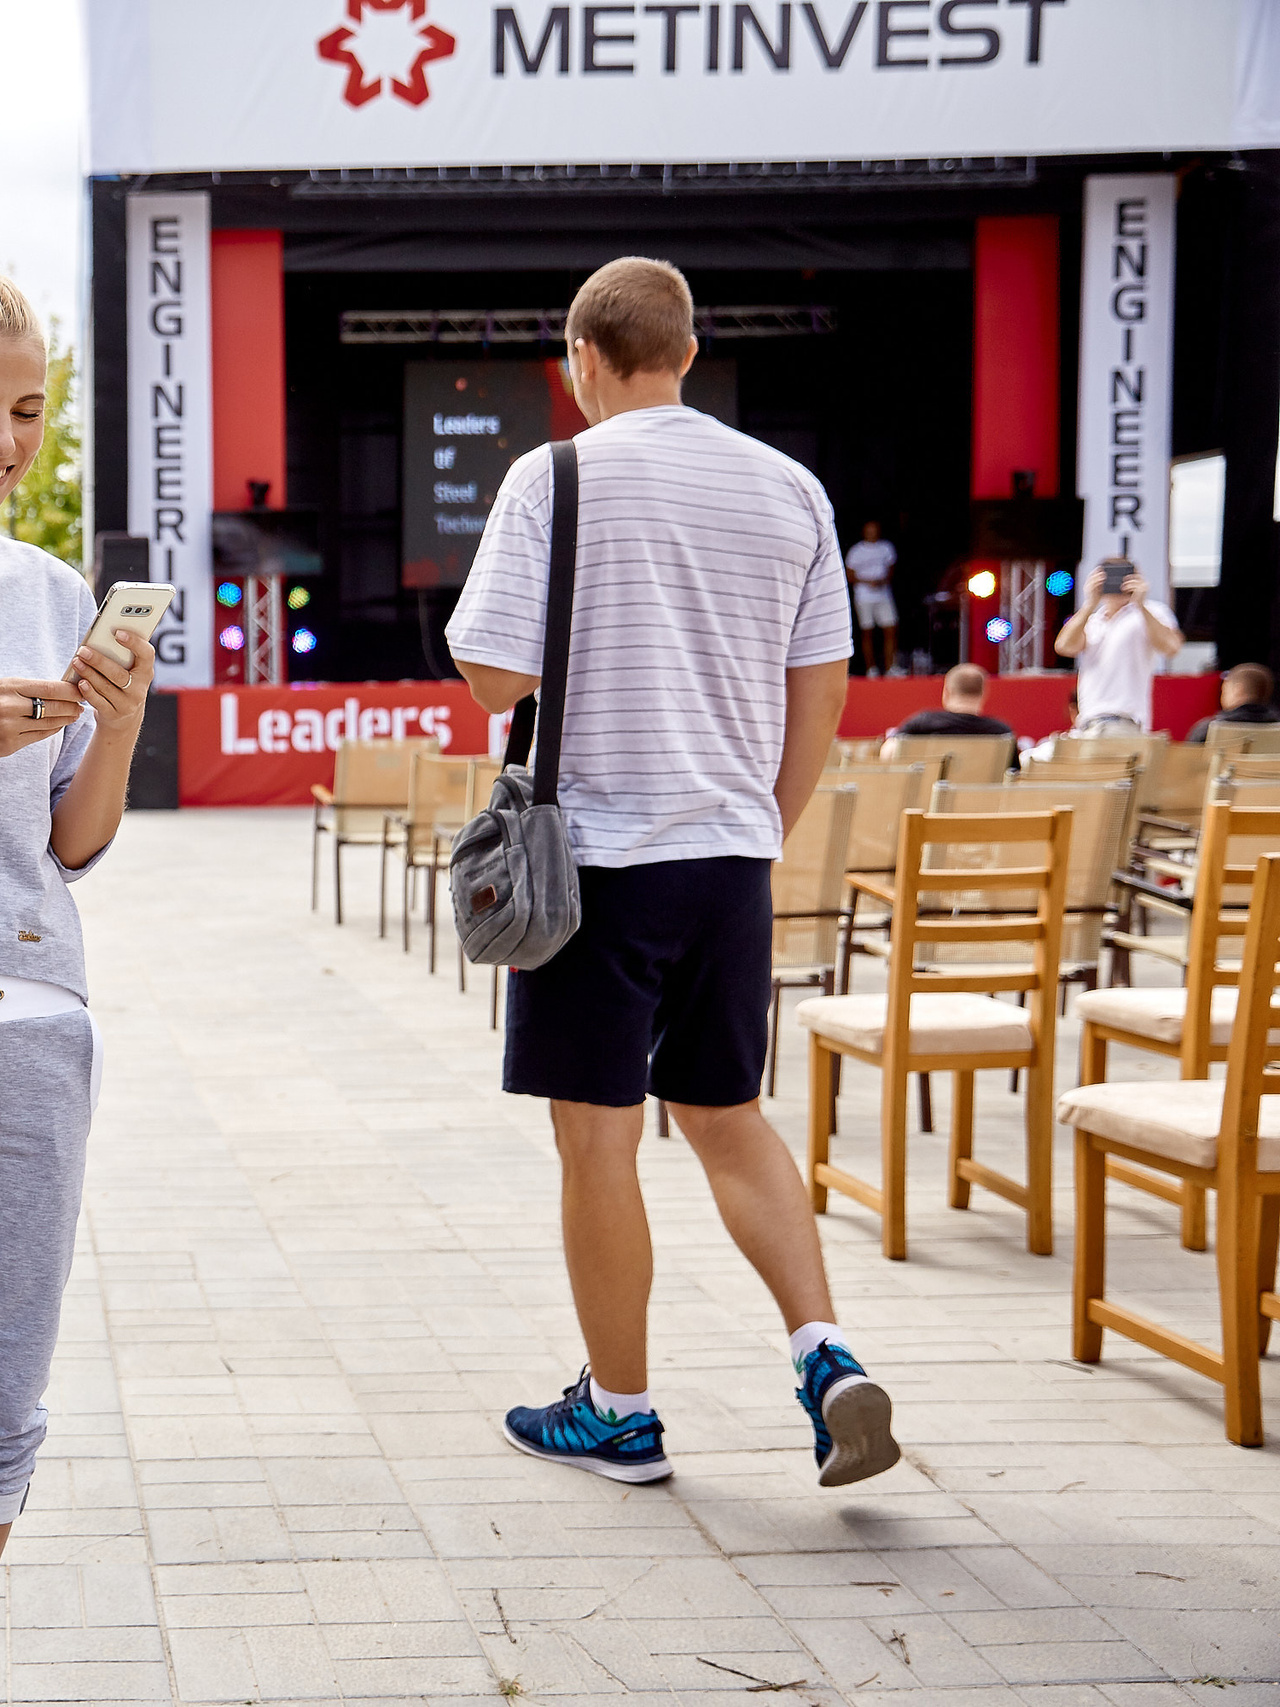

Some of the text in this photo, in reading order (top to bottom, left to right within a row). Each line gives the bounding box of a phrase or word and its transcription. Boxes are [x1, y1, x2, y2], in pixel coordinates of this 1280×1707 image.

[494, 0, 1067, 76] METINVEST
[1109, 198, 1148, 559] ENGINEERI
[433, 412, 500, 435] Leaders
[220, 693, 452, 755] Leaders
